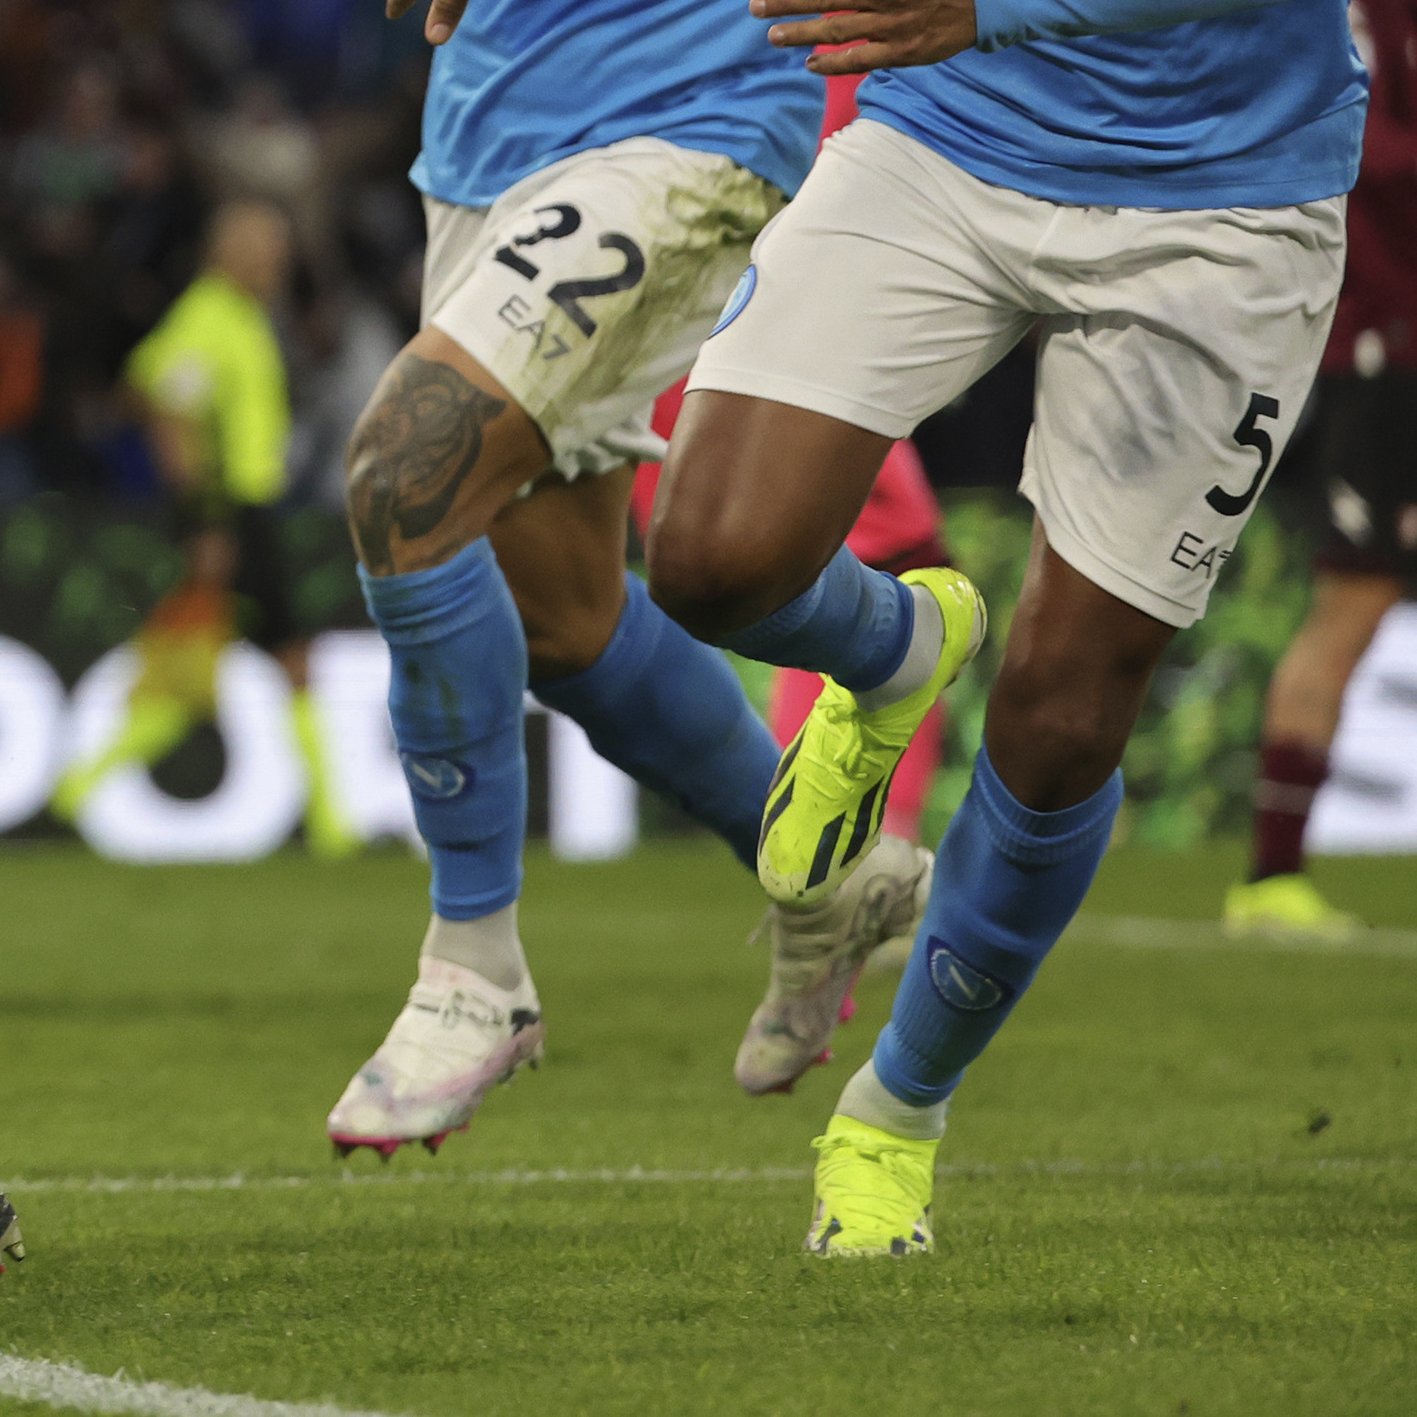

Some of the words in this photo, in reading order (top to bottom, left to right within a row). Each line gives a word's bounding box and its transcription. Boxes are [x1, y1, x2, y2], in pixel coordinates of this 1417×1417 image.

[493, 201, 646, 340] 22
[497, 292, 571, 361] EA7
[1204, 391, 1280, 517] 5
